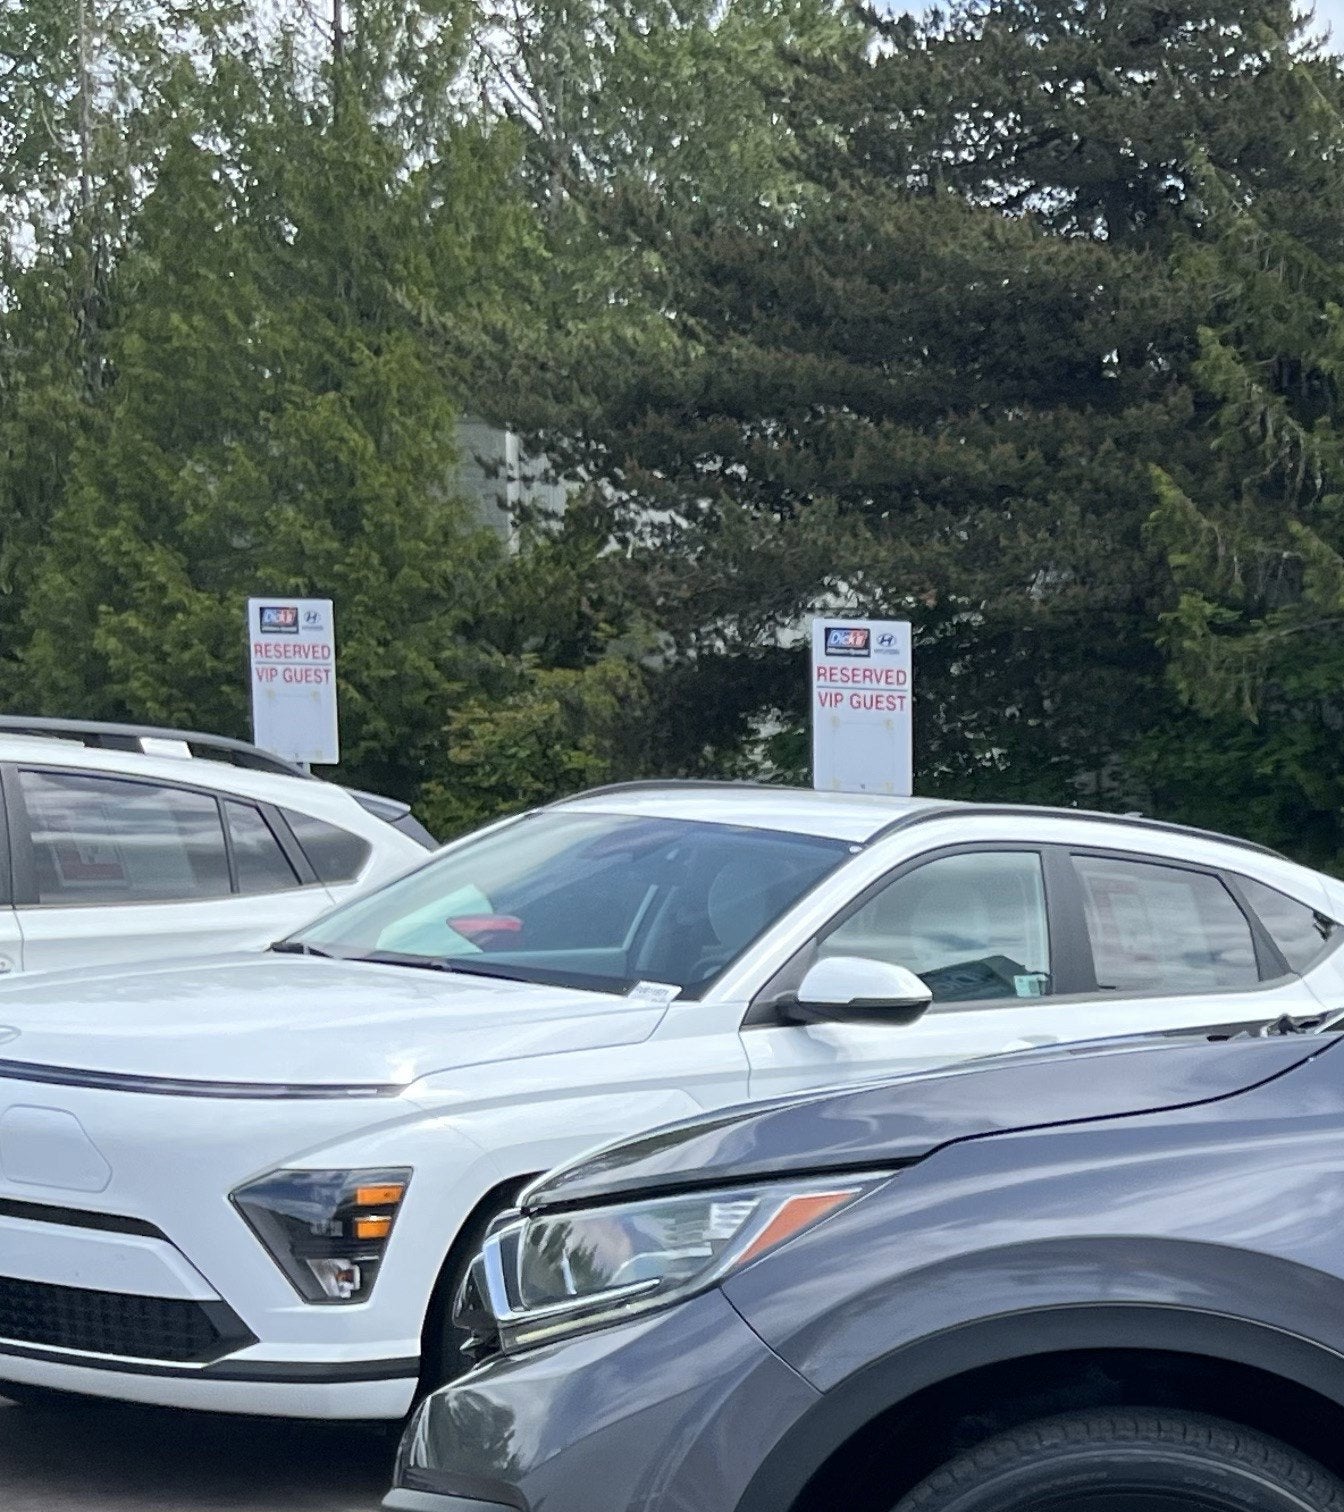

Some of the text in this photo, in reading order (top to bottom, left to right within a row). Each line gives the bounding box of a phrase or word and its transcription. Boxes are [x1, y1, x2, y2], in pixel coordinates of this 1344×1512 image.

[254, 643, 331, 660] RESERVED
[256, 667, 331, 684] VIP GUEST
[816, 666, 907, 686] RESERVED
[818, 691, 907, 712] VIP GUEST
